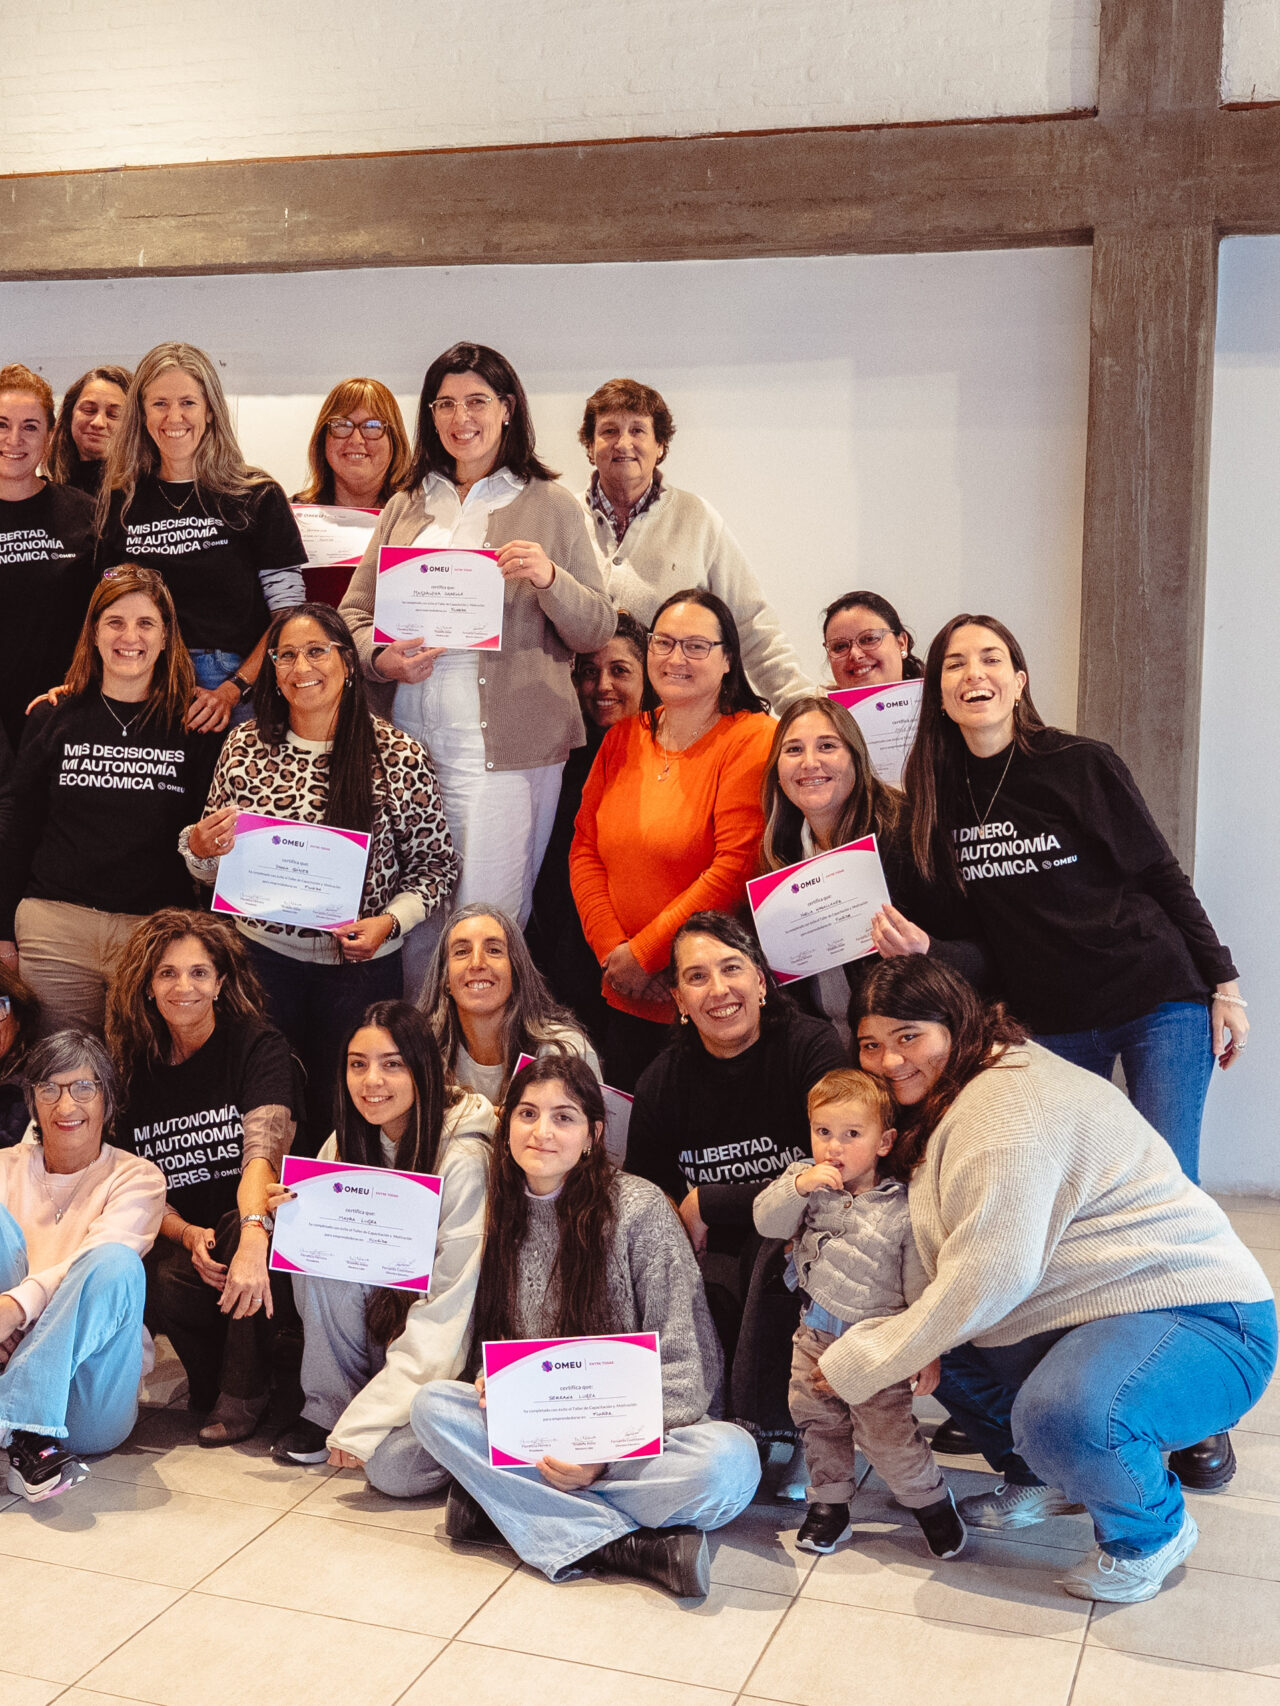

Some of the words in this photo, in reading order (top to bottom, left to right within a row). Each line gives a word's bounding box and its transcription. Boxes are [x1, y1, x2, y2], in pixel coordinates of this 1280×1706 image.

[126, 536, 142, 546] MI
[143, 526, 218, 546] AUTONOMÍA
[127, 524, 151, 535] MIS
[126, 540, 201, 555] ECONÓMICA
[886, 700, 909, 709] OMEU
[64, 743, 90, 757] MIS
[92, 744, 185, 763] DECISIONES
[62, 758, 79, 770] MI
[80, 759, 177, 777] AUTONOMÍA
[59, 773, 155, 790] ECONÓMICA
[960, 821, 1018, 842] DINERO,
[282, 838, 305, 848] OMEU
[961, 833, 1061, 861] AUTONOMÍA
[962, 859, 1039, 881] ONÓMICA
[1053, 855, 1078, 866] OMEU
[800, 876, 821, 889] OMEU
[134, 1125, 150, 1142] MI
[157, 1149, 207, 1172] TODAS
[207, 1143, 241, 1161] LAS
[695, 1136, 778, 1164] LIBERTAD,
[698, 1146, 807, 1182] AUTONOMÍA
[166, 1168, 211, 1190] JERES
[344, 1185, 370, 1195] OMEU
[554, 1361, 582, 1370] OMEU
